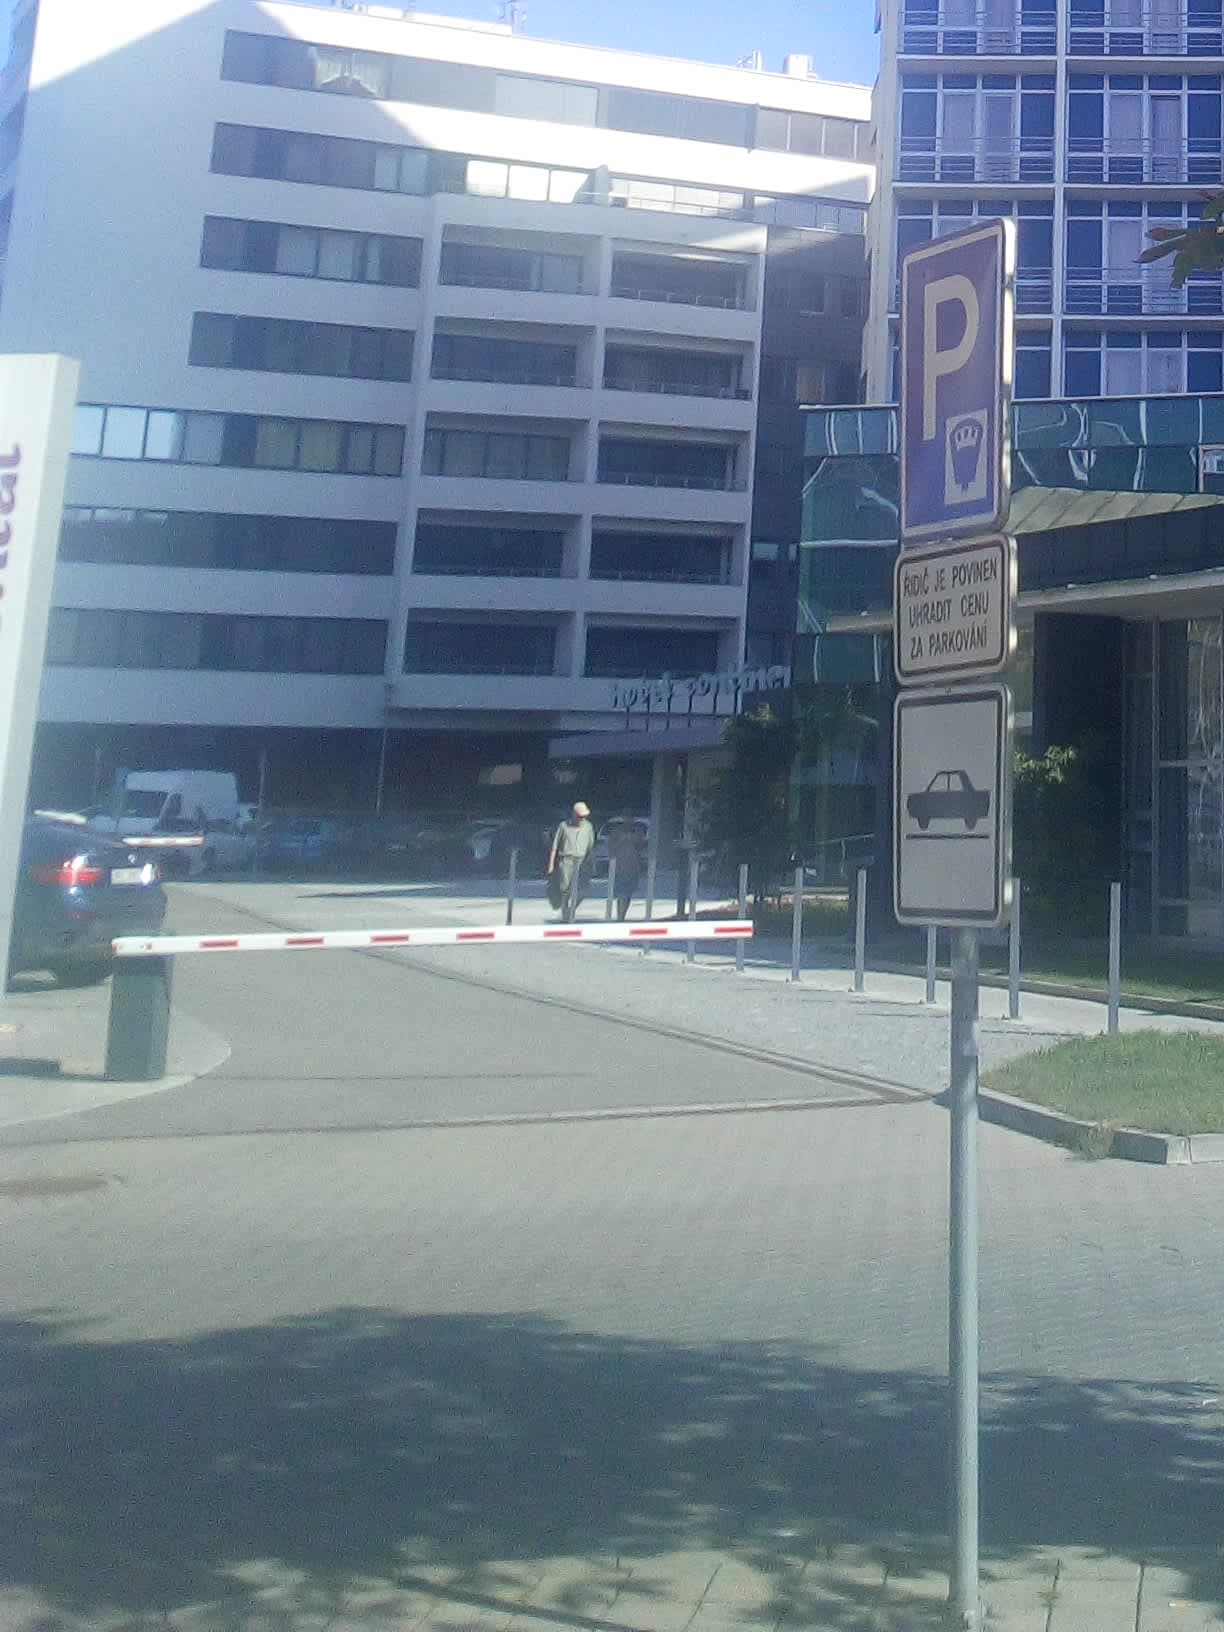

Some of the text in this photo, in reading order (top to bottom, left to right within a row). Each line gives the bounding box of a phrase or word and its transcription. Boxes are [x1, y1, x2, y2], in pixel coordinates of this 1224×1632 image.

[923, 274, 980, 441] P
[903, 556, 997, 597] ŘIDIČ JE POVINEN
[908, 590, 989, 627] UHRADIT CENU
[911, 619, 988, 659] ZA PARKOVÁNÍ
